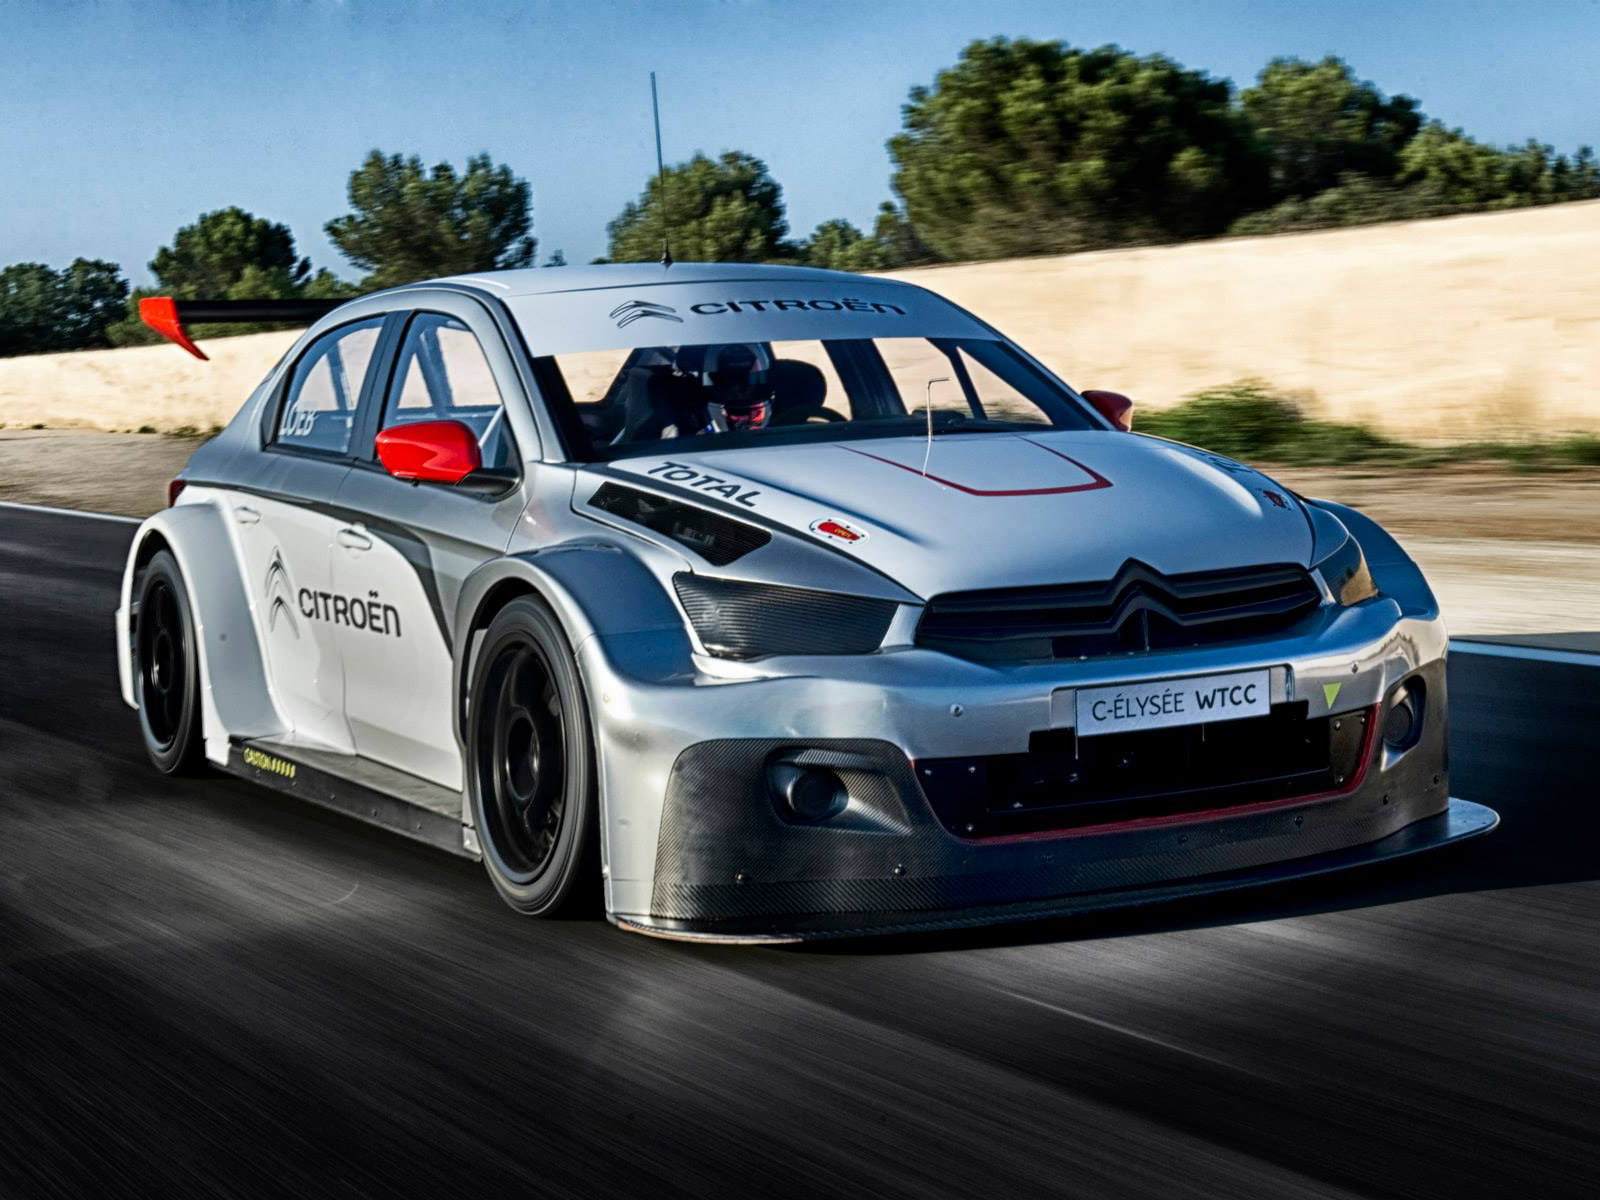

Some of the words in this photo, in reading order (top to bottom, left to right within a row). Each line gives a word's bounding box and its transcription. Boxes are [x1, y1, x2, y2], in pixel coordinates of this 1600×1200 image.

[647, 461, 760, 507] TOTAL
[1092, 688, 1185, 721] C-ÉLYSÉE
[1195, 684, 1257, 710] WTCC
